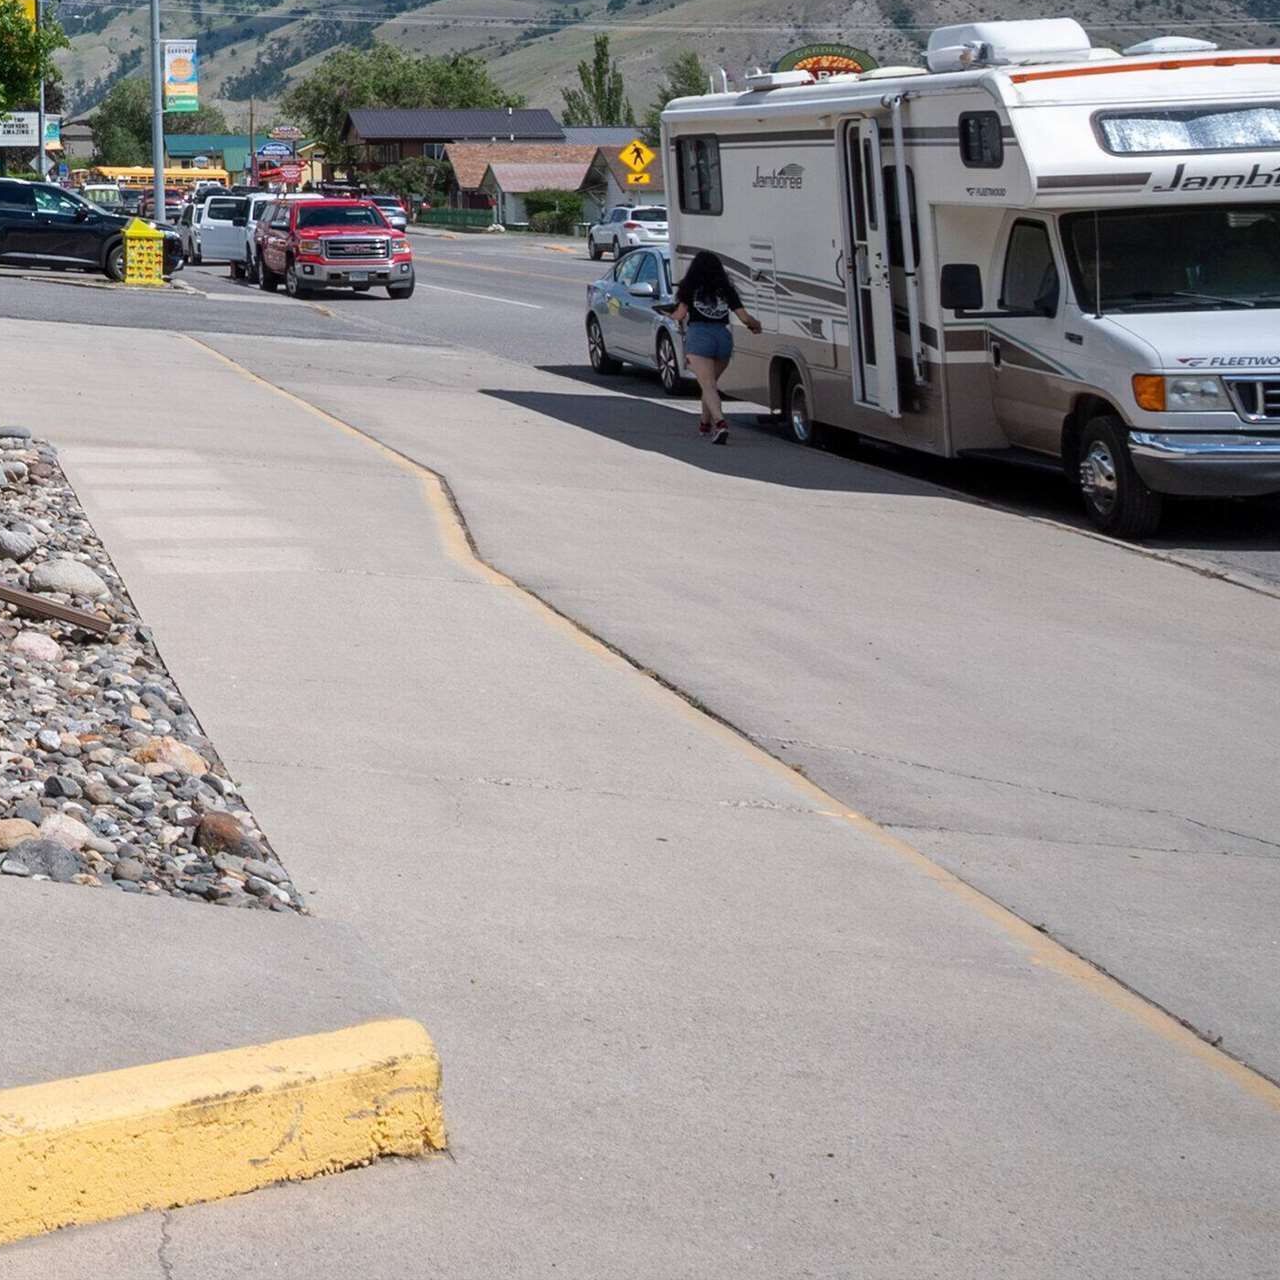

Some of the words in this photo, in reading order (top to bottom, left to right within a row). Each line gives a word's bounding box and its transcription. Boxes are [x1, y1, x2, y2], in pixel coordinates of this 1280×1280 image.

[752, 165, 802, 189] Jamboree
[1151, 163, 1280, 192] Jamb
[1209, 356, 1280, 366] FLEETWO
